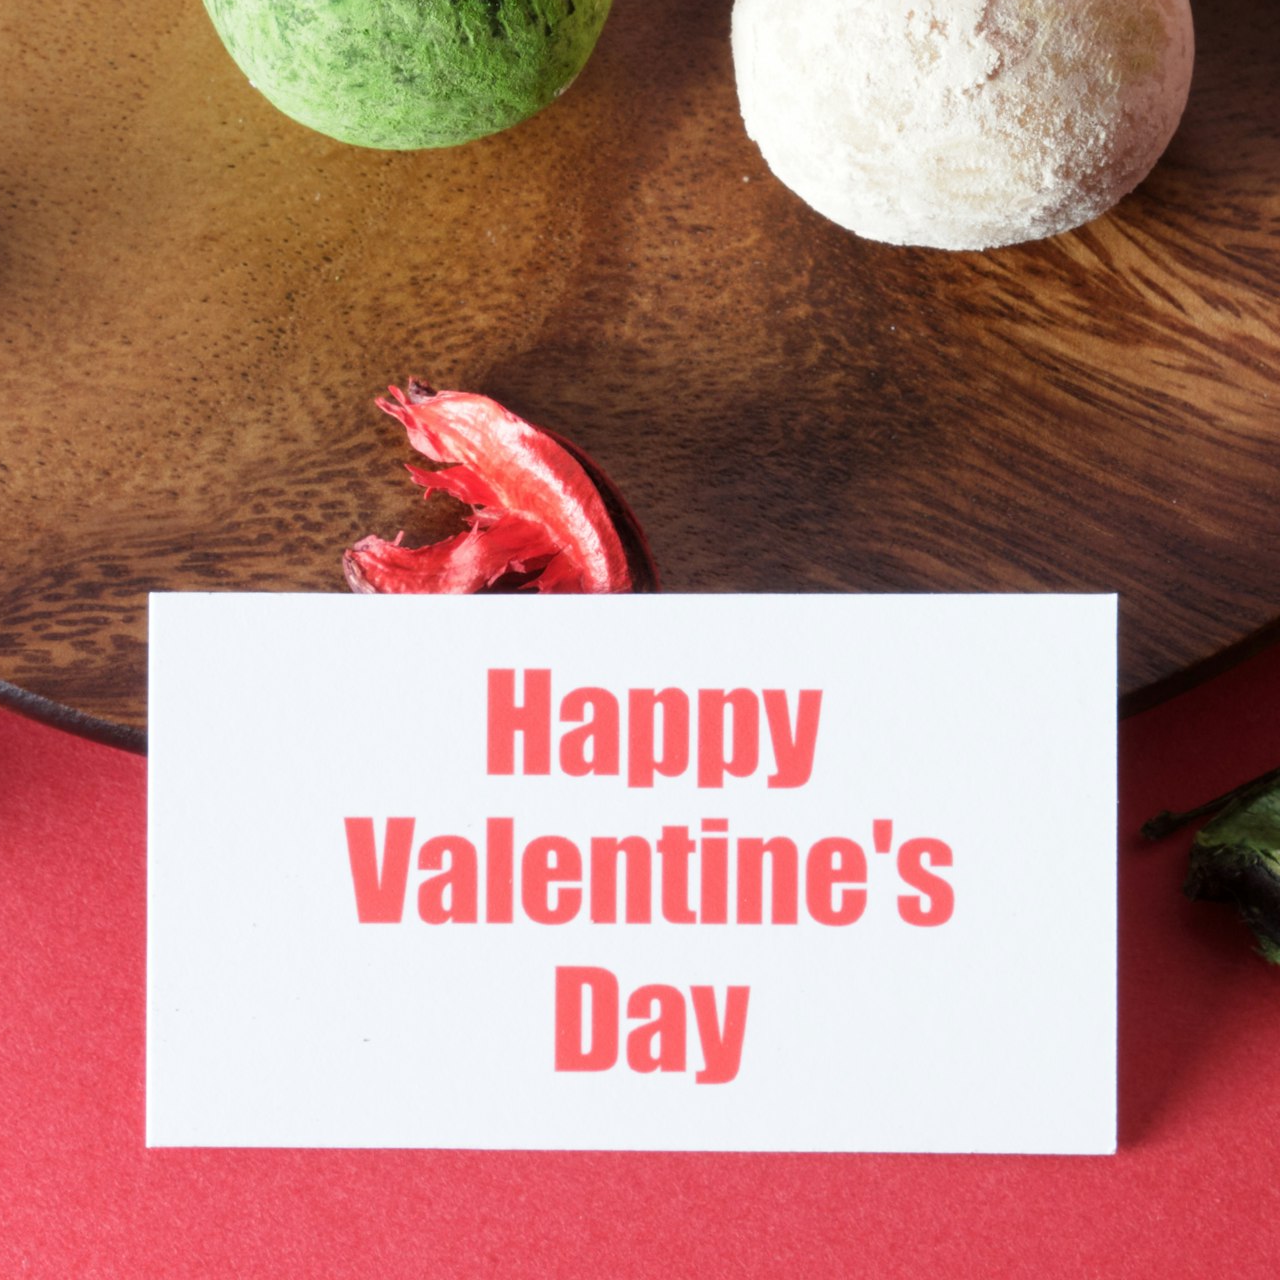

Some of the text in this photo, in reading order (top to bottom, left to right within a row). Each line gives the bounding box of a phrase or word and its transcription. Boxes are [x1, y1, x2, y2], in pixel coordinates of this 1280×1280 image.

[486, 668, 823, 789] Happy
[343, 816, 955, 928] Valentine's
[554, 965, 751, 1085] Day
